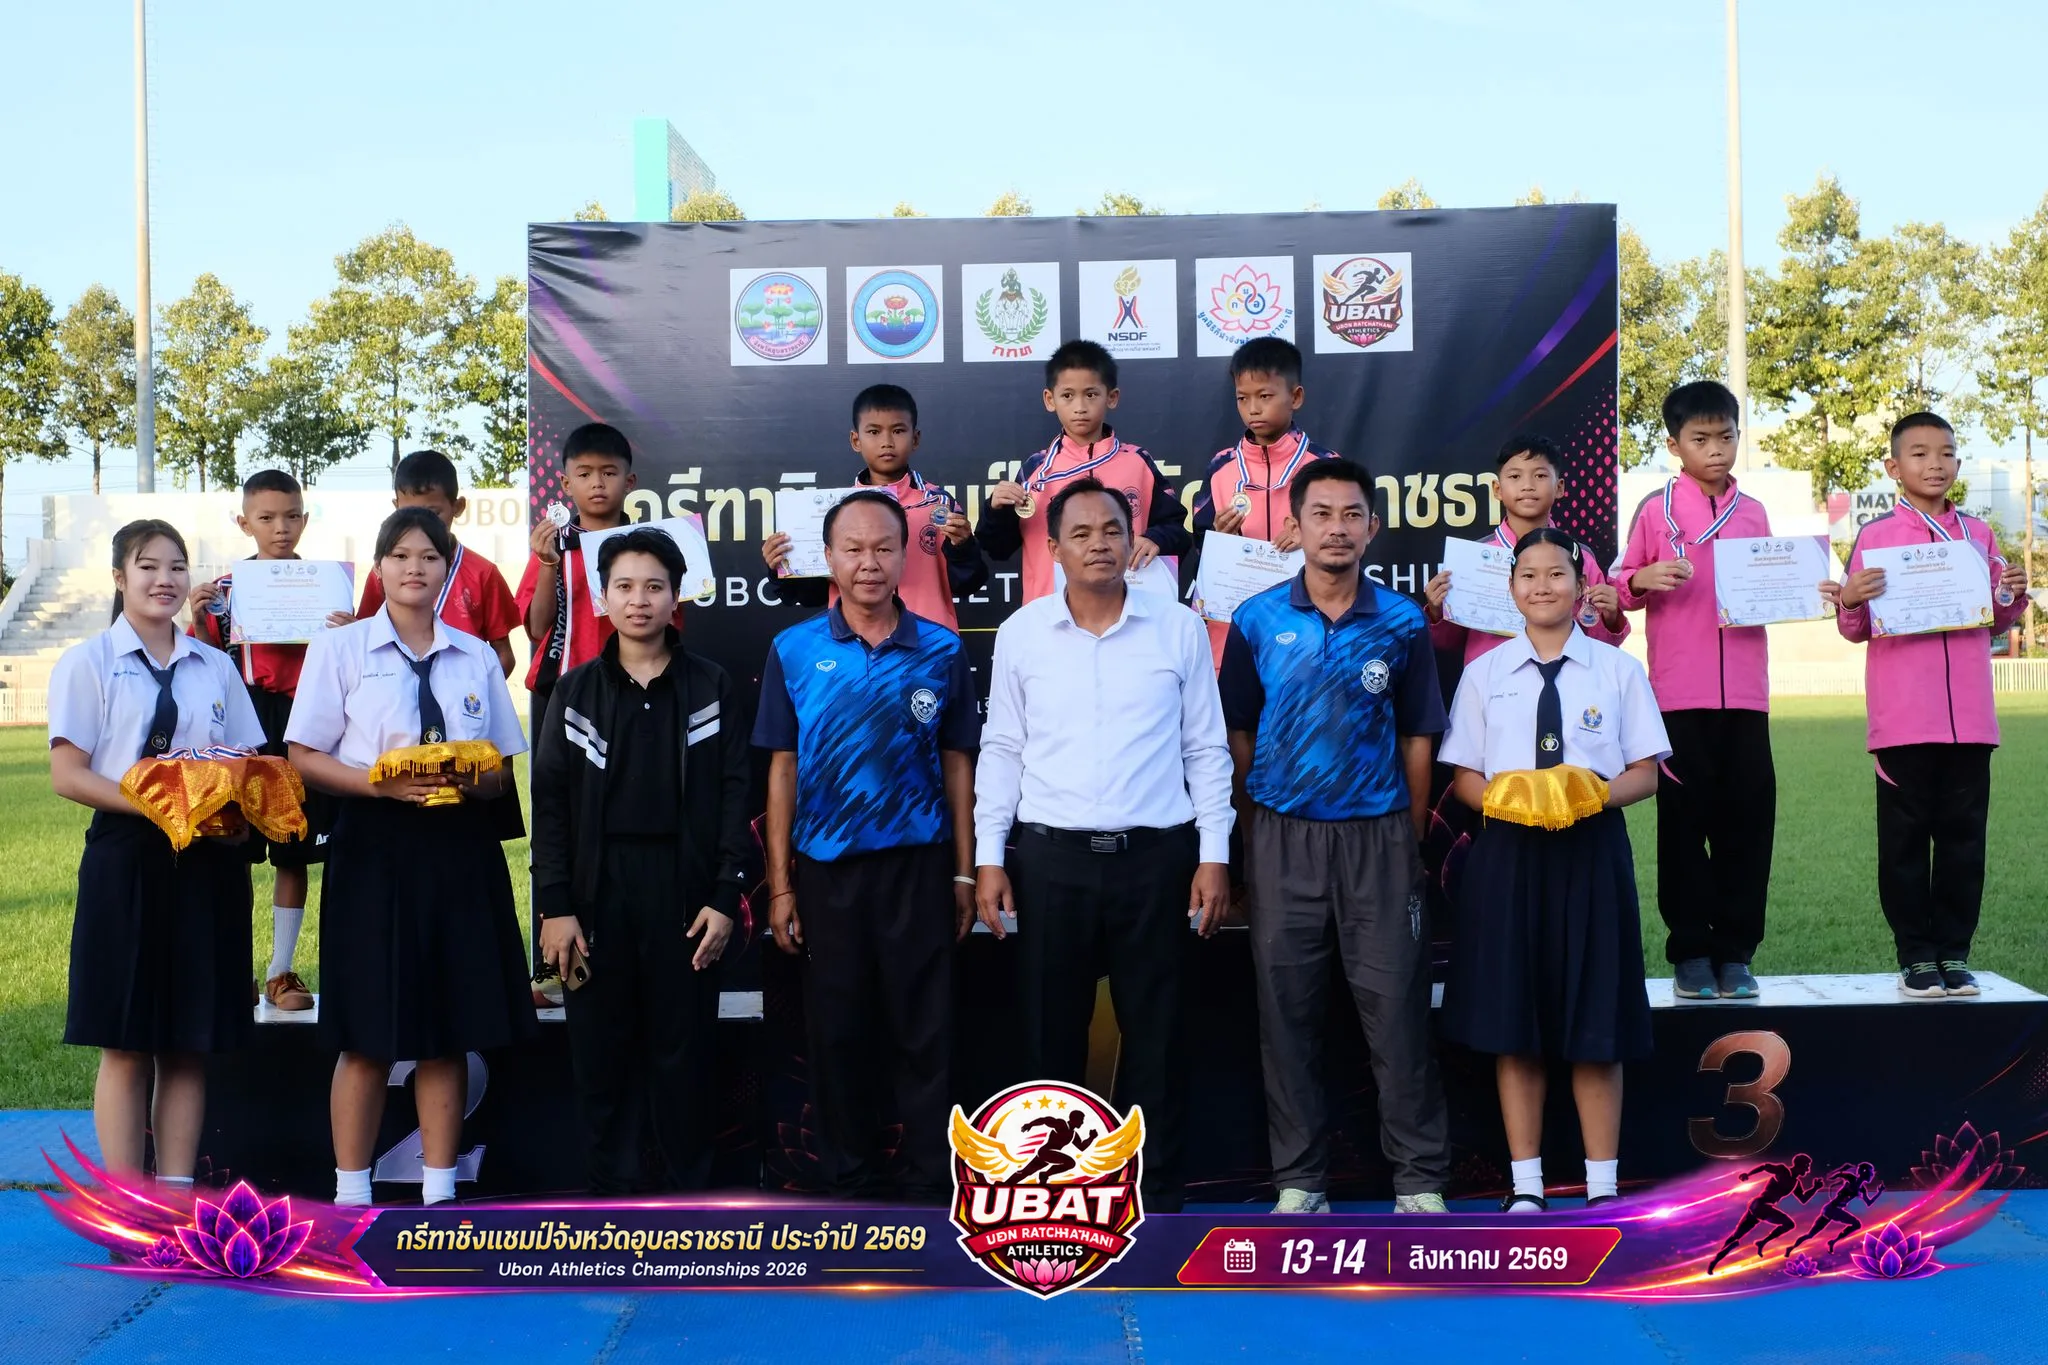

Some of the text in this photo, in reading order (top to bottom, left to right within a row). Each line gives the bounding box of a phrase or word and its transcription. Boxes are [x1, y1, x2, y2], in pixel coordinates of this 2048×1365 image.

[1330, 303, 1397, 321] UBAT
[1108, 332, 1147, 342] NSDF
[1687, 1030, 1791, 1159] 3
